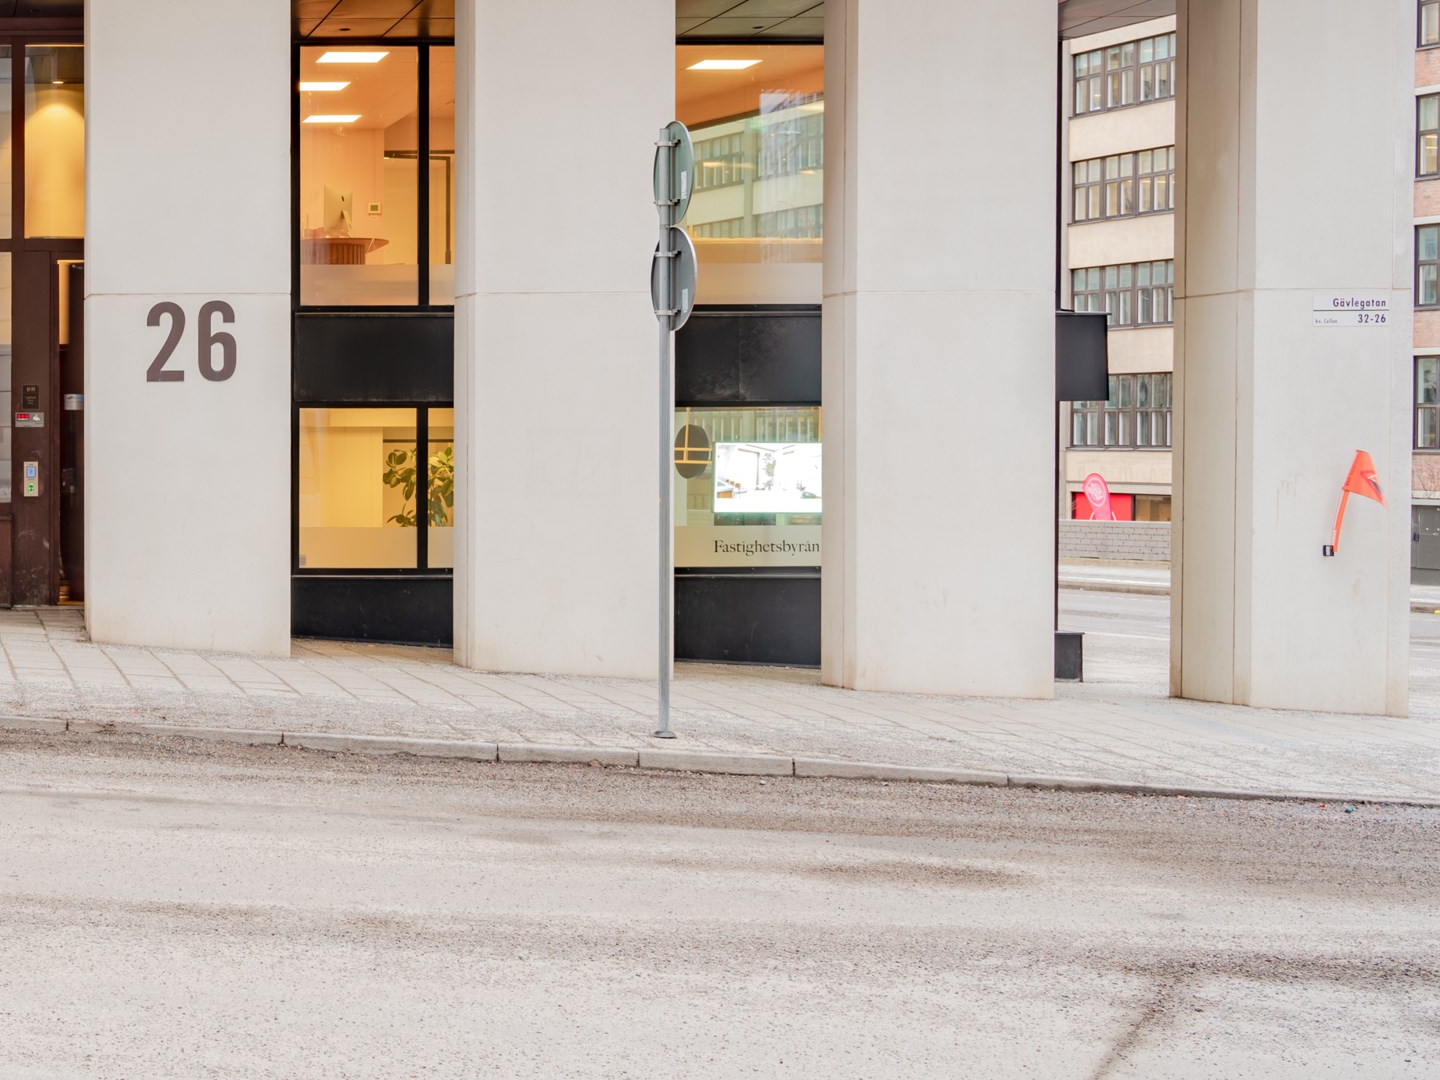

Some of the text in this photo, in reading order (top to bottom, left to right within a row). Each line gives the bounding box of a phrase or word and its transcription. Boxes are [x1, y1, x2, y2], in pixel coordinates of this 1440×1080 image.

[1332, 297, 1386, 310] Gävlegatan
[1357, 313, 1386, 324] 32-26
[146, 300, 237, 382] 26
[714, 540, 820, 556] Fastighetsbyrån
